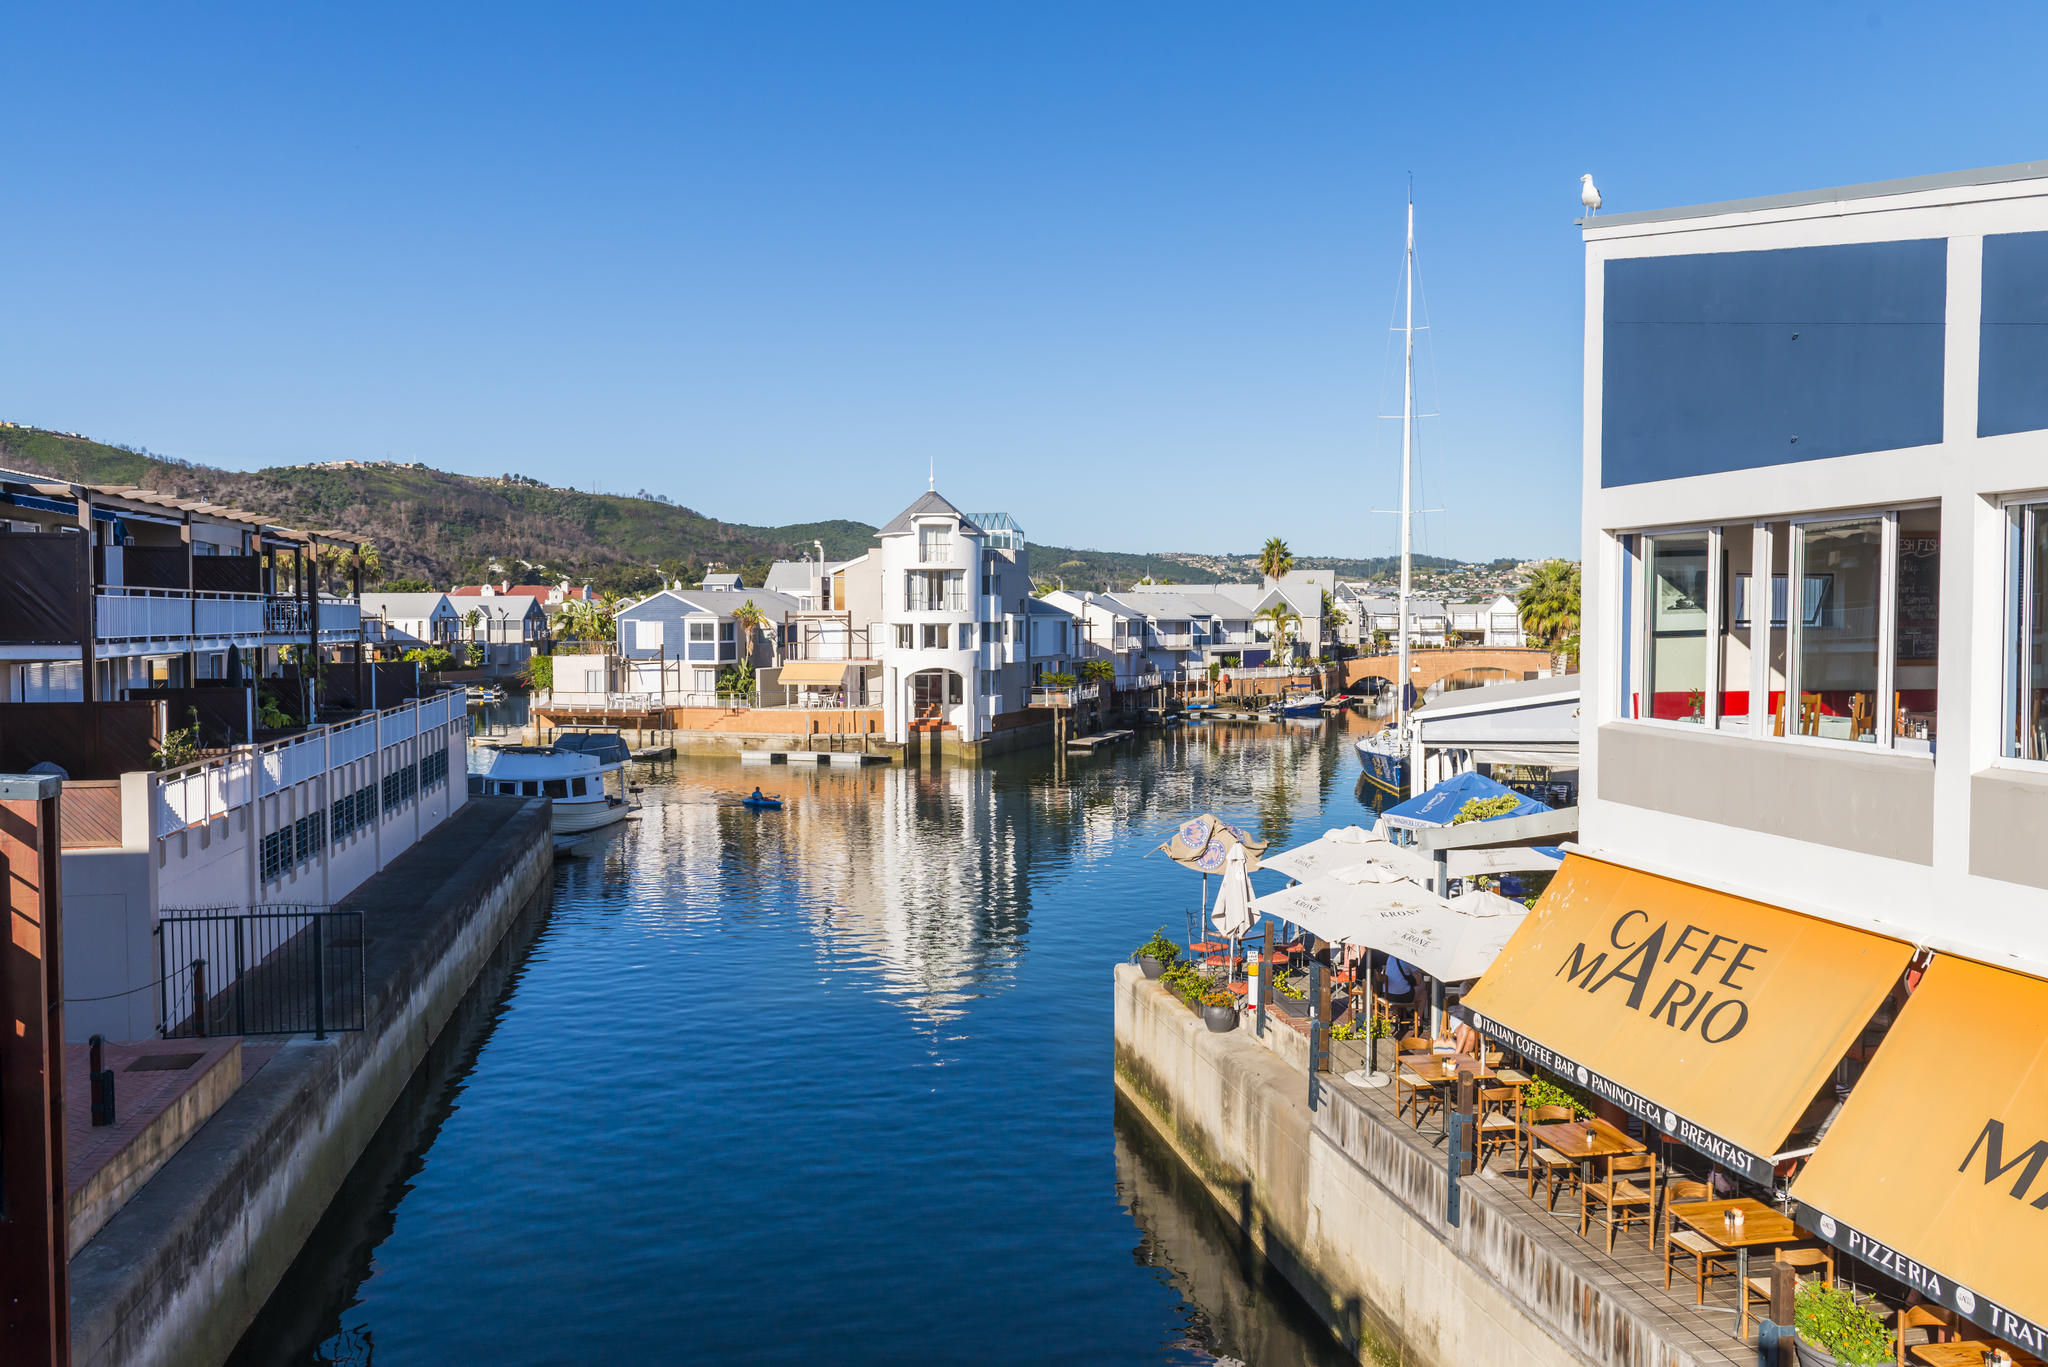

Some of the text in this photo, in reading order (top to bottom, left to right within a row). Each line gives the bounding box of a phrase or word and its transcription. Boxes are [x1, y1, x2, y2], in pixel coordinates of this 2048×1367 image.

[1293, 899, 1319, 913] KRONE
[1401, 932, 1431, 948] KRONE
[1610, 909, 1768, 1010] CAFFE
[1555, 920, 1749, 1044] MARIO
[1482, 1018, 1514, 1045] ITALIAN
[1516, 1035, 1552, 1066] COFFEE
[1554, 1055, 1575, 1078] BAR
[1591, 1074, 1661, 1124] PANINOTECA
[1680, 1120, 1754, 1173] BREAKFAST
[1849, 1229, 1941, 1297] PIZZERIA
[1989, 1304, 2048, 1351] TRAT
